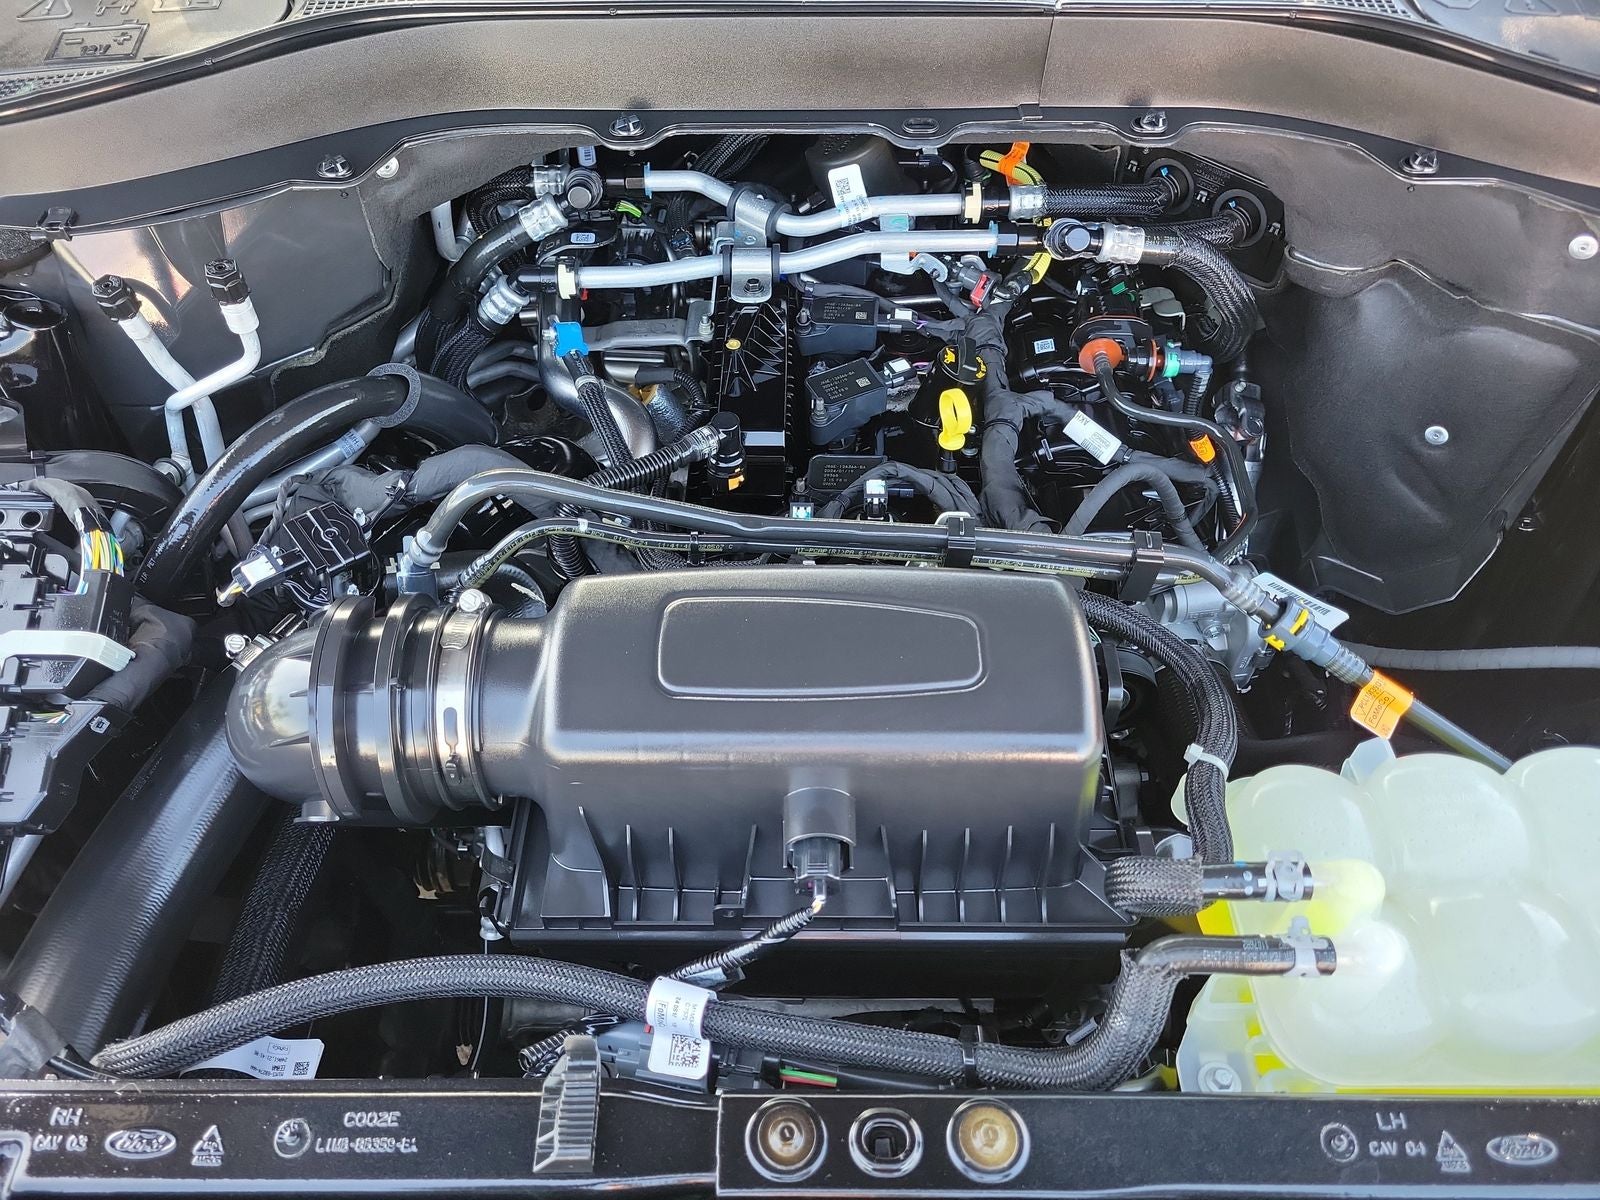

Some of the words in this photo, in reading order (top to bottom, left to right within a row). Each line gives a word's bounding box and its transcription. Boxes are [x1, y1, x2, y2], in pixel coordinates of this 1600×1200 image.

[50, 1107, 83, 1126] RH
[1375, 1112, 1407, 1130] LH
[1369, 1140, 1398, 1157] CAV
[1405, 1140, 1427, 1157] 04
